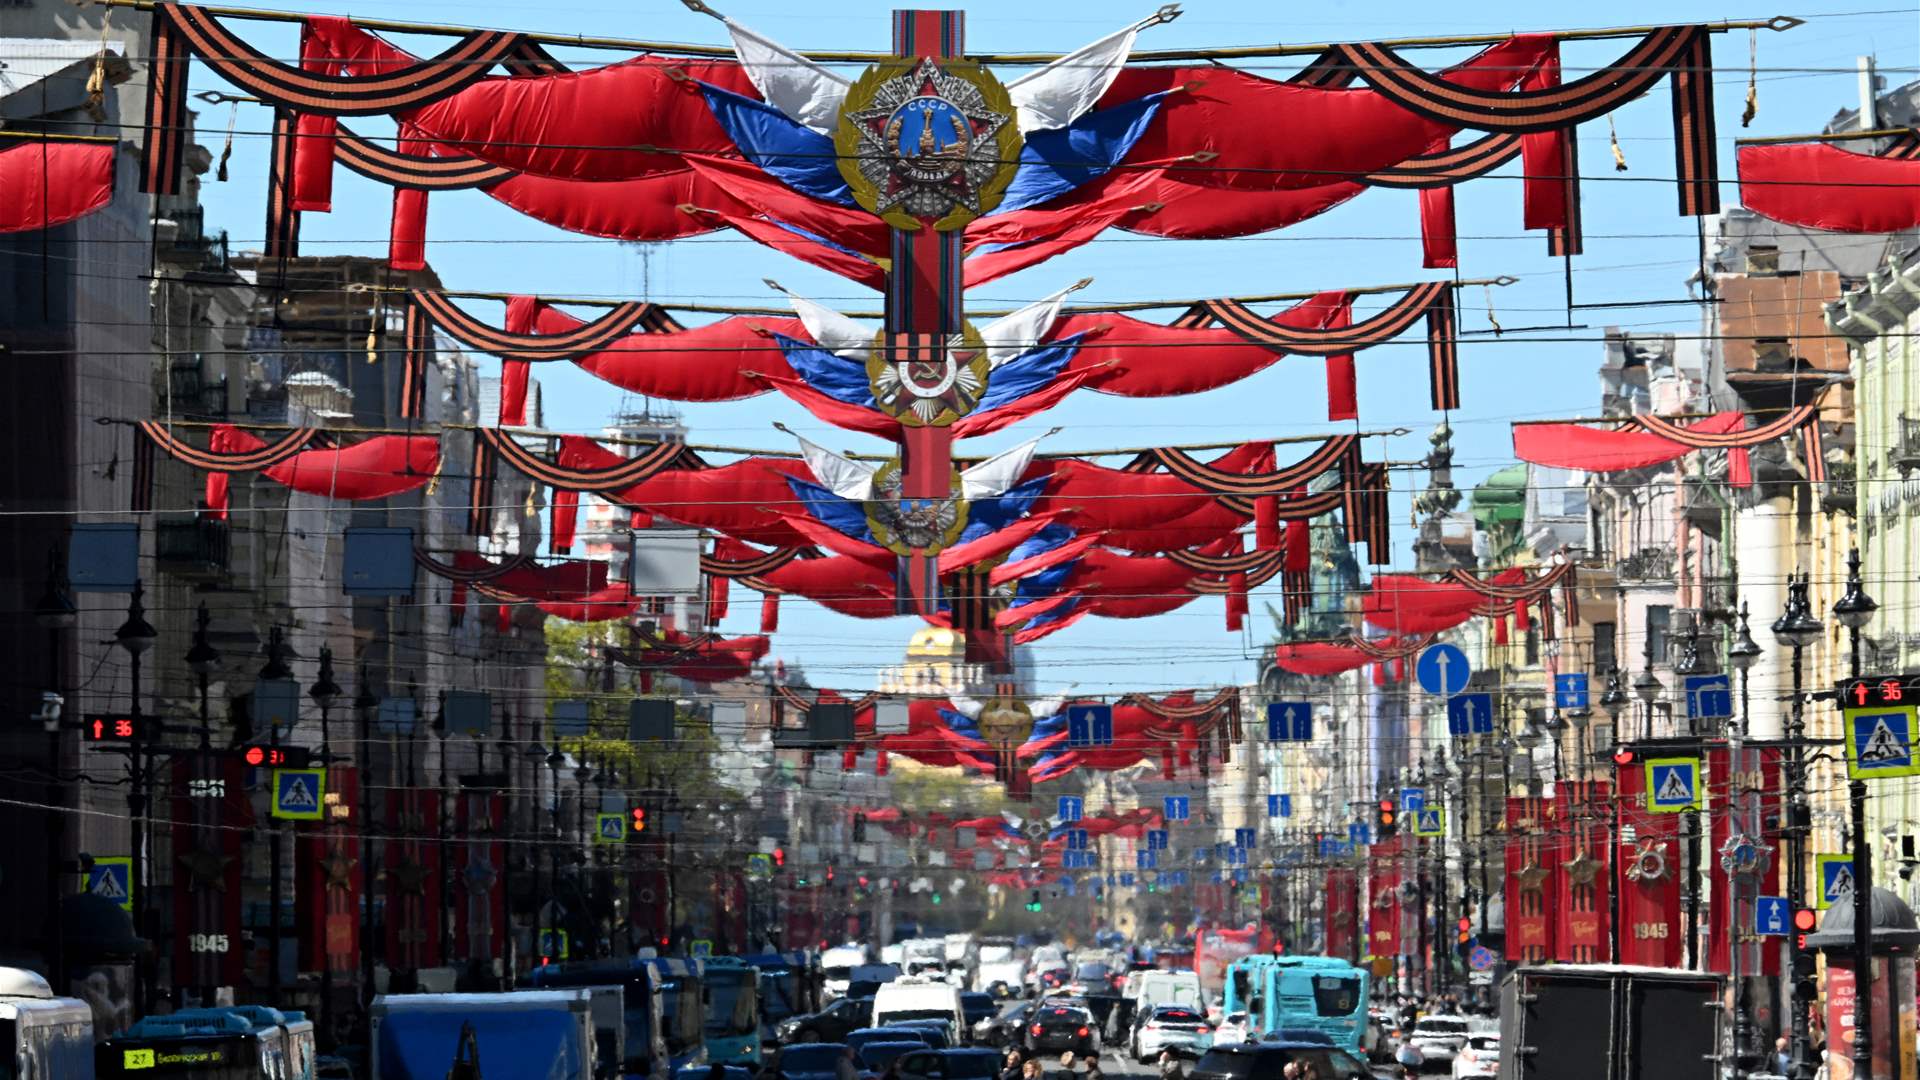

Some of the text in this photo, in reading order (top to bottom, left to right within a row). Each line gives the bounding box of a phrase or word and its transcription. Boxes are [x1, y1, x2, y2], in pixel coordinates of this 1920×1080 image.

[908, 99, 948, 112] СССР
[1882, 682, 1902, 700] 36
[115, 720, 132, 737] 36
[1633, 922, 1668, 939] 1945
[187, 934, 229, 953] 1945
[132, 1053, 146, 1065] 27
